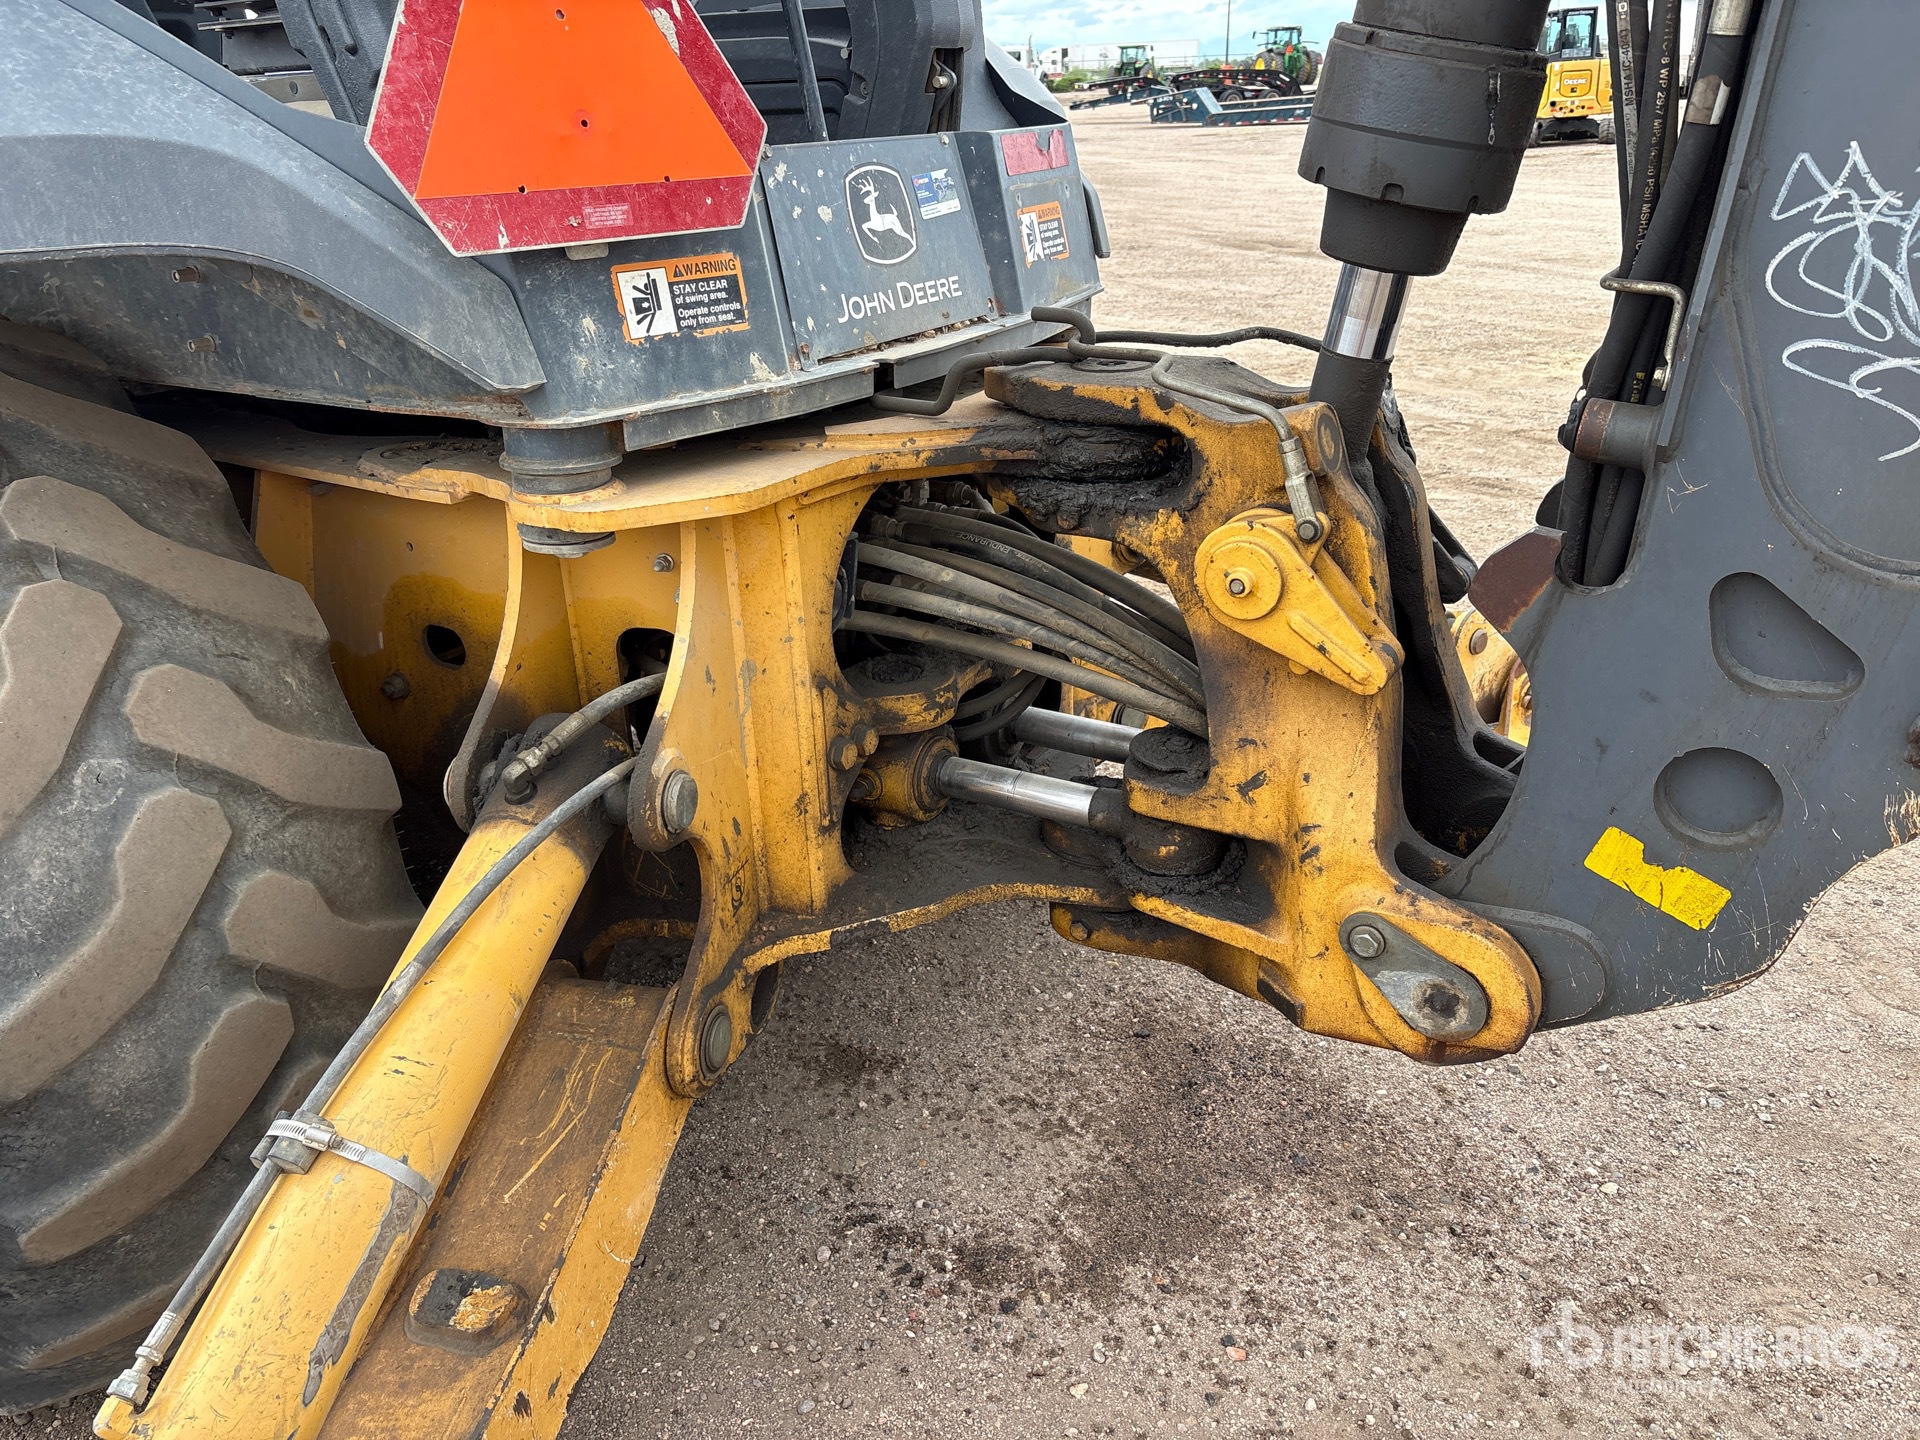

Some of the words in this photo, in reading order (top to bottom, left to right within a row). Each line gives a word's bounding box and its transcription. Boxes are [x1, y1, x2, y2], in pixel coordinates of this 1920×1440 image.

[1658, 67, 1670, 88] WP
[1624, 74, 1634, 107] MSHA
[1637, 203, 1652, 237] MSHA
[682, 258, 737, 276] WARNING
[673, 283, 696, 295] STAY
[698, 279, 728, 293] CLEAR
[675, 296, 684, 305] of
[685, 293, 709, 304] swing
[709, 290, 729, 300] area.
[837, 289, 896, 323] JOHN
[896, 275, 963, 309] DEERE
[677, 306, 709, 319] Operate
[710, 301, 741, 314] controls
[680, 317, 698, 328] only
[698, 315, 717, 325] from
[717, 311, 737, 322] seat.
[956, 532, 1010, 554] ENDURANCE
